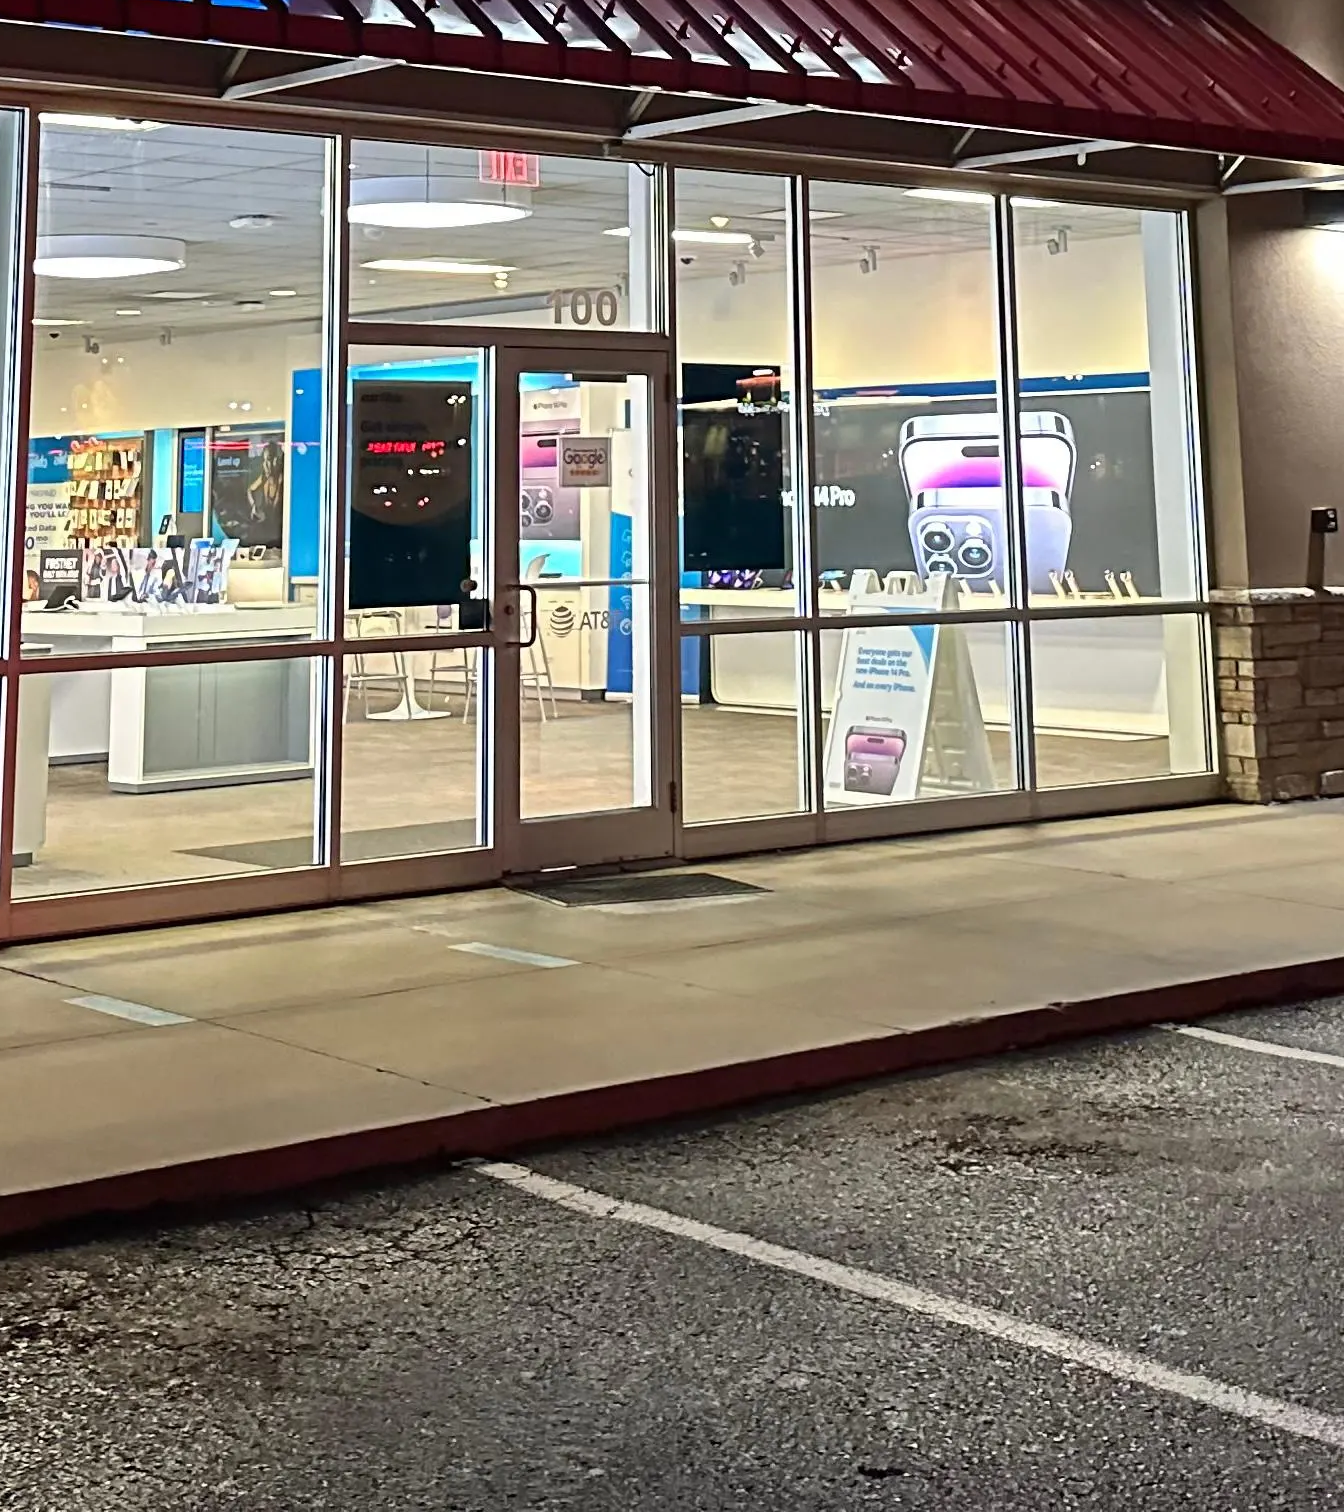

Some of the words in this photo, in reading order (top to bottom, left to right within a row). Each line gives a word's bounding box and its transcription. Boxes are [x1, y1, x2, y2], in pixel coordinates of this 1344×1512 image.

[546, 288, 618, 326] 100
[830, 486, 856, 506] Pro
[39, 524, 57, 532] Data
